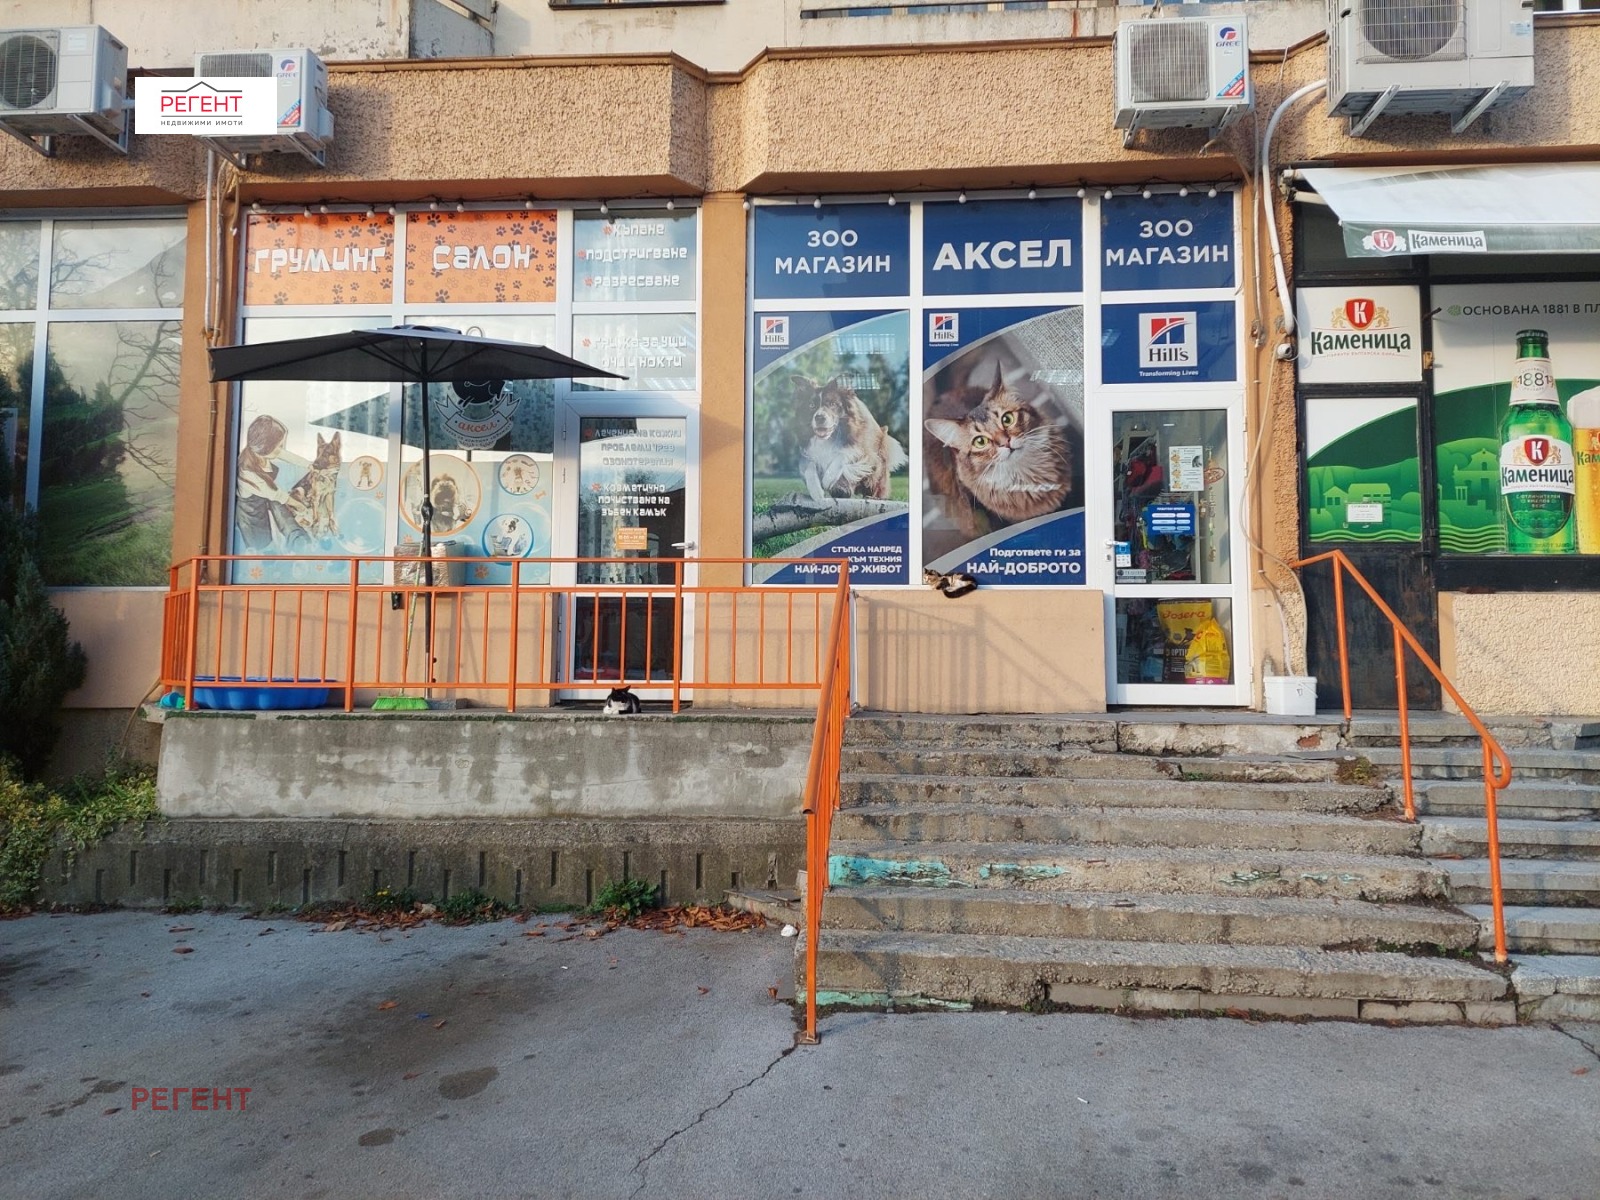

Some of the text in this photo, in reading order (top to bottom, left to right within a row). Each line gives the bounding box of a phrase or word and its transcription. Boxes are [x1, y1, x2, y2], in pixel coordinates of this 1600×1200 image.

[807, 229, 859, 247] ЗОО
[1139, 219, 1193, 238] ЗОО
[1411, 233, 1483, 249] Каменица
[932, 239, 1072, 271] АКСЕЛ
[1106, 245, 1228, 267] МАГАЗИН
[775, 255, 891, 275] МАГАЗИН
[1354, 302, 1367, 324] К
[1462, 305, 1540, 316] ОСНОВАНА
[1542, 304, 1569, 315] 1881
[1573, 304, 1580, 313] В
[1311, 331, 1411, 355] Каменица
[1149, 347, 1189, 362] Hill's
[1532, 441, 1543, 460] К
[1501, 466, 1574, 487] Каменица
[990, 548, 1052, 557] Подгответе
[1054, 548, 1066, 556] ги
[861, 565, 902, 574] ЖИВОТ
[966, 560, 1081, 575] НАЙ-ДОБРОТО
